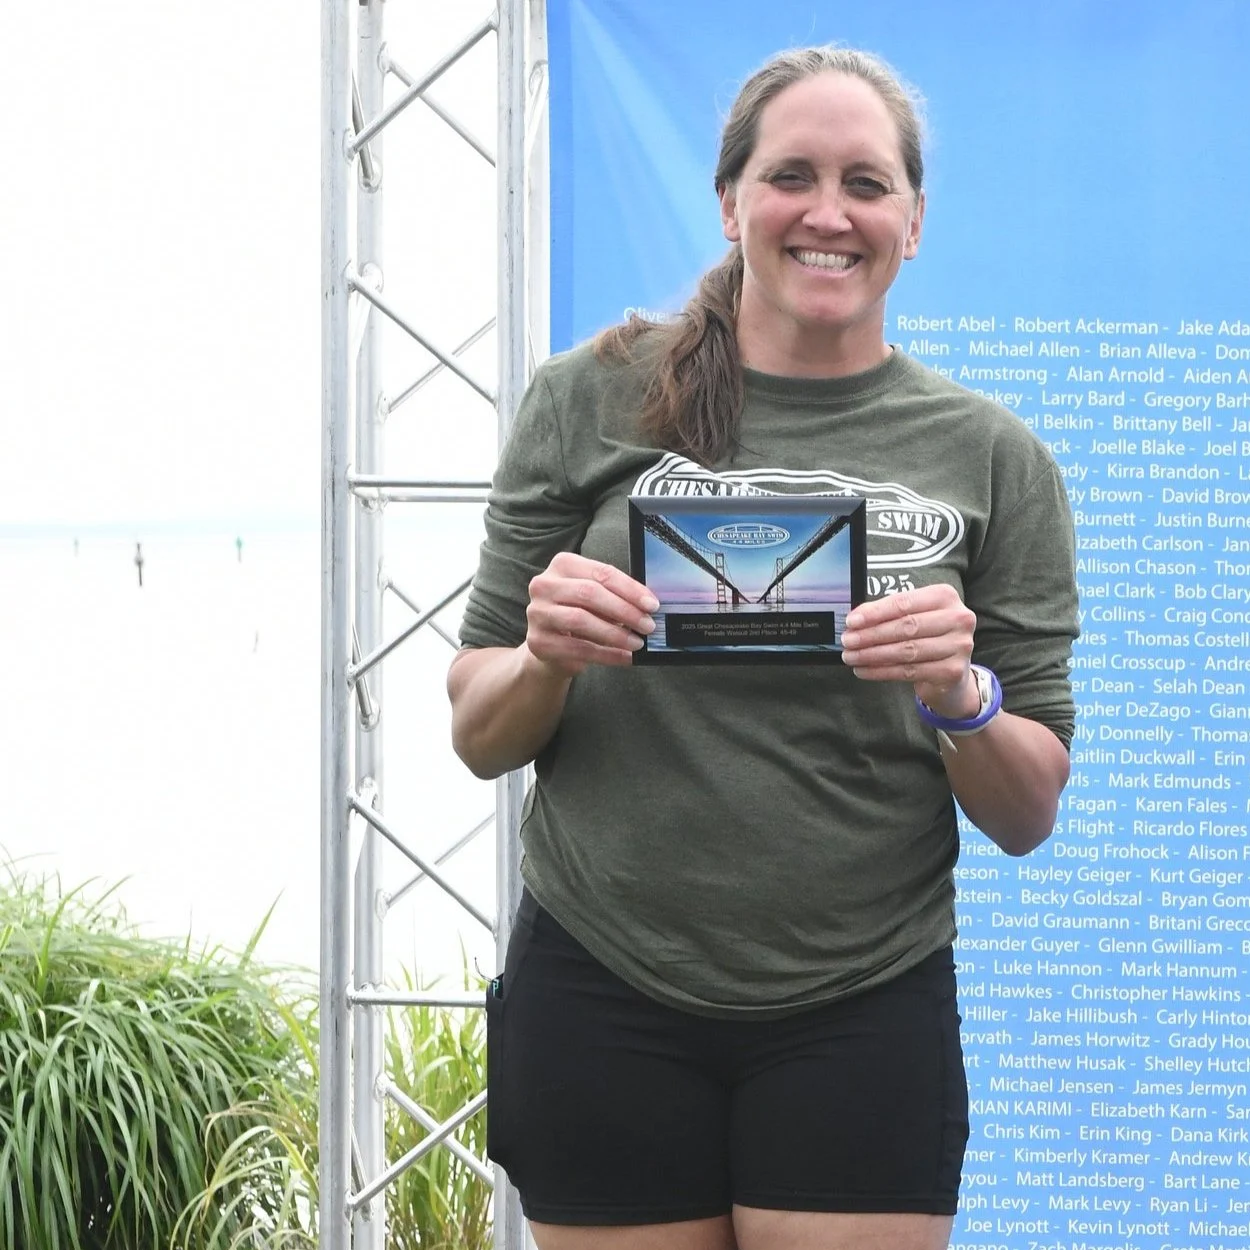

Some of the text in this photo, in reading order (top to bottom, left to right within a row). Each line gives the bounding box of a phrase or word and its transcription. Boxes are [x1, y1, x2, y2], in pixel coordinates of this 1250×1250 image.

[897, 314, 1159, 335] Robert Abel Robert Ackerman
[1041, 390, 1084, 410] Larry
[1087, 390, 1125, 407] Bard
[1143, 391, 1212, 412] Gregory
[878, 511, 942, 541] SWIM
[1154, 511, 1203, 528] Justin
[867, 574, 915, 596] 025
[1153, 678, 1198, 694] Selah
[1202, 678, 1245, 695] Dean
[1018, 865, 1244, 888] Hayley Geiger Kurt Geiger
[994, 959, 1237, 978] Luke Hannon Mark Hannum
[983, 1123, 1152, 1146] Chris Kim Erin King
